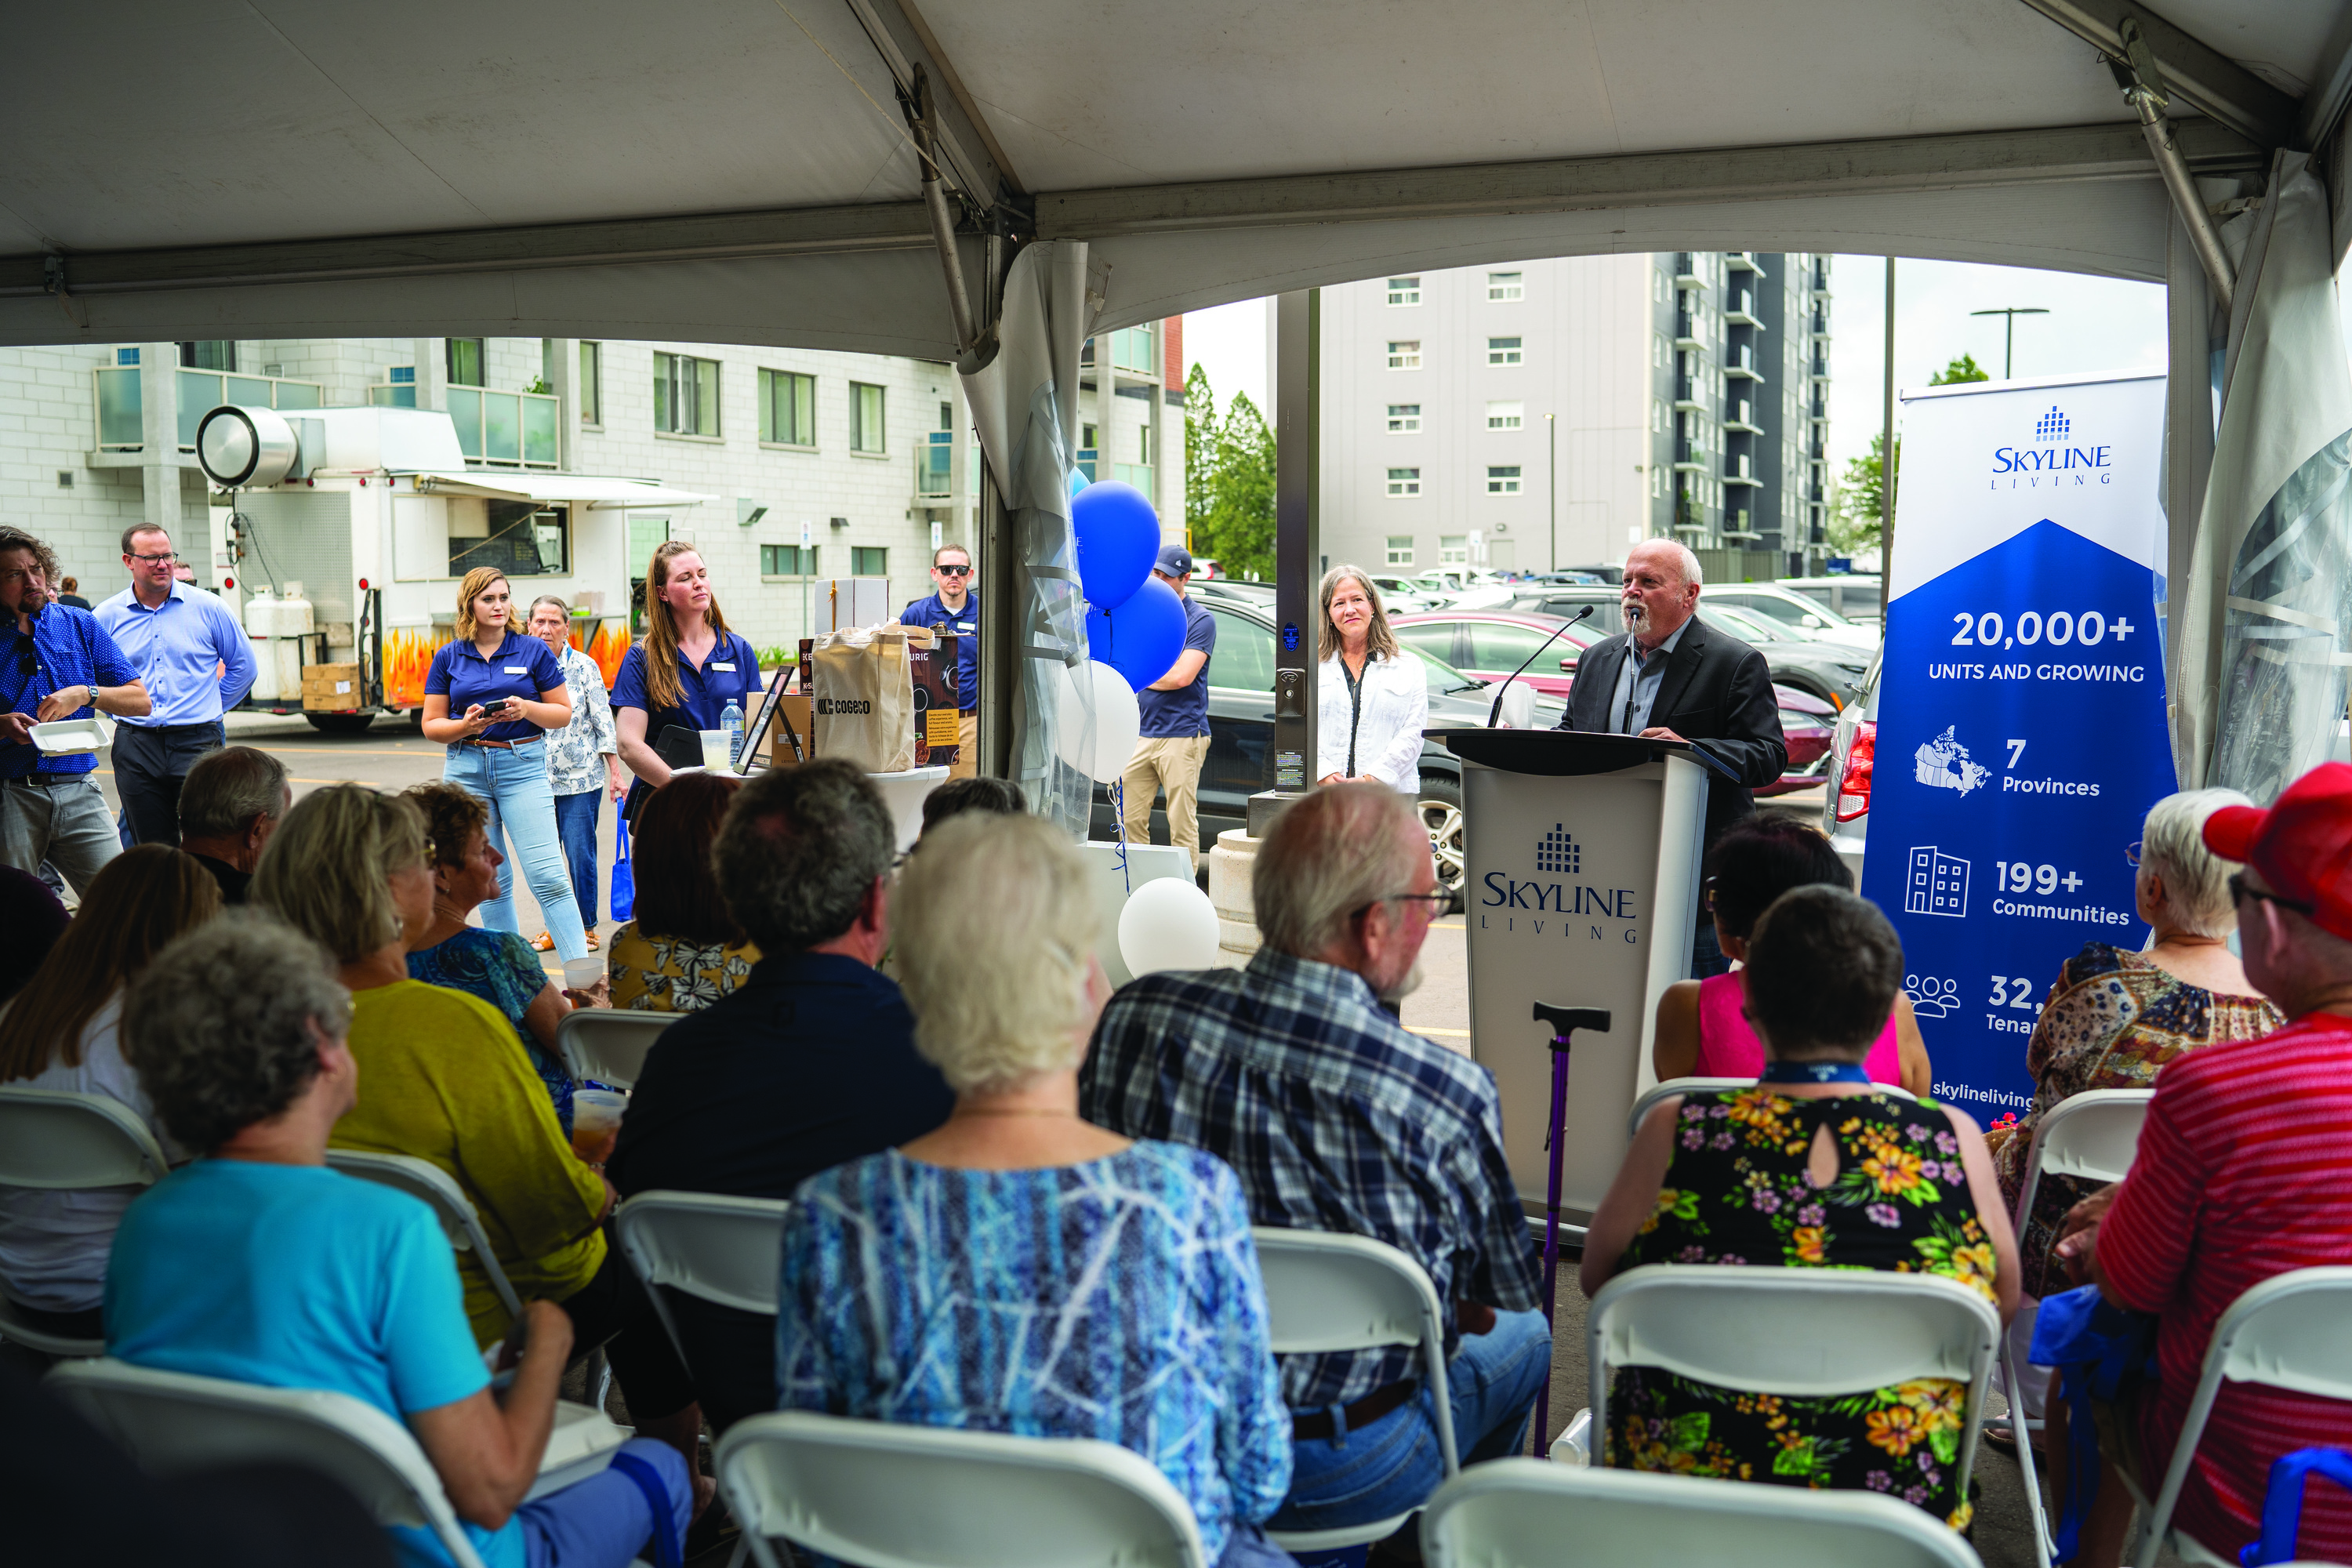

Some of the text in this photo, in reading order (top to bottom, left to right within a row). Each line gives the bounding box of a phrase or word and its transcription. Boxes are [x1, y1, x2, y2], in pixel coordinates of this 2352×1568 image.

[1992, 445, 2111, 474] SKYLINE
[1991, 474, 2110, 490] LIVING
[1951, 611, 2135, 651] 20,000+
[1929, 663, 2144, 682] UNITS AND GROWING
[2006, 739, 2027, 769] 7
[2002, 776, 2100, 797] Provinces
[1996, 861, 2083, 895] 199+
[1482, 871, 1637, 920] SKYLINE
[1992, 898, 2129, 926] Communities
[1482, 915, 1637, 944] LIVING
[1988, 975, 2056, 1014] 32,
